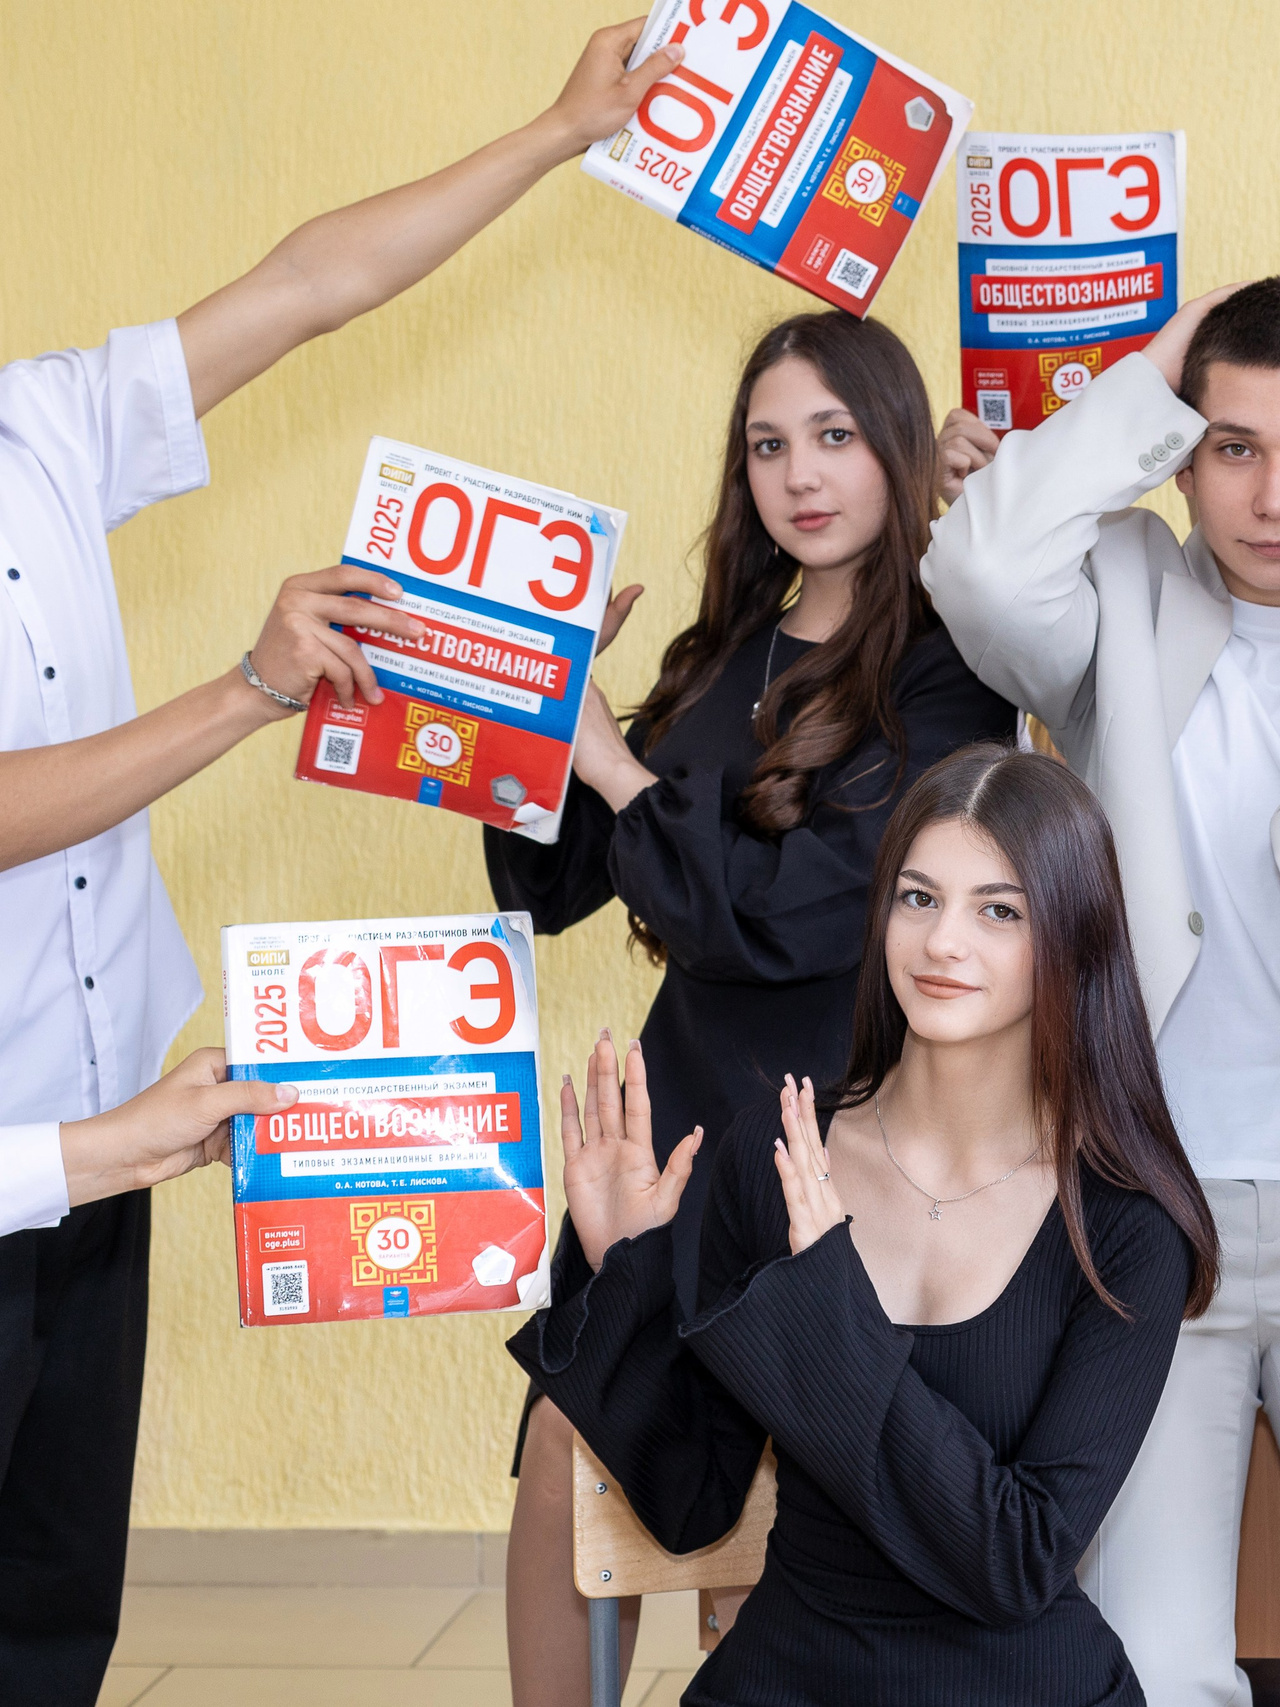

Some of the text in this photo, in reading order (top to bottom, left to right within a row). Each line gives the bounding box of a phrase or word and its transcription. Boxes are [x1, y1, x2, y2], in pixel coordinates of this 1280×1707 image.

[637, 0, 770, 153] ОГЭ
[730, 44, 834, 221] ОБЩЕСТВОЗНАНИЕ
[635, 147, 692, 192] 2025
[852, 168, 874, 194] 30
[998, 154, 1160, 238] ОГЭ
[971, 183, 992, 237] 2025
[980, 272, 1154, 309] ОБЩЕСТВОЗНАНИЕ
[1060, 371, 1083, 388] 30
[379, 479, 408, 494] ШКОЛЕ
[381, 464, 412, 484] ФИПИ
[424, 462, 452, 479] ПРОЕКТ
[454, 473, 460, 481] С
[462, 474, 501, 494] УЧАСТИЕМ
[503, 487, 565, 514] РАЗРАБОТЧИКОВ
[568, 508, 582, 520] КИМ
[366, 495, 403, 560] 2025
[407, 482, 594, 612] ОГЭ
[424, 603, 506, 636] ГОСУДАРСТВЕННЫЙ
[508, 629, 546, 647] ЭКЗАМЕН
[369, 652, 532, 705] ТИПОВЫЕ ЭКЗАМЕНАЦИОННЫЕ ВАРИАНТЫ
[461, 699, 493, 714] ЛИСКОВА
[424, 729, 454, 753] 30
[472, 928, 489, 936] КИМ
[250, 952, 286, 964] ФИПИ
[251, 968, 286, 976] ШКОЛЕ
[298, 942, 516, 1052] ОГЭ
[256, 984, 288, 1054] 2025
[343, 1081, 438, 1095] ГОСУДАРСТВЕННЫЙ
[443, 1080, 487, 1090] ЭКЗАМЕН
[293, 1158, 335, 1169] ТИПОВЫЕ
[340, 1153, 433, 1168] ЭКЗАМЕНАЦИОННЫЕ
[355, 1179, 388, 1189] КОТОВА,
[409, 1177, 446, 1186] ЛИСКОВА
[264, 1230, 299, 1239] включи
[265, 1237, 299, 1249] oge.plus
[377, 1228, 409, 1251] 30
